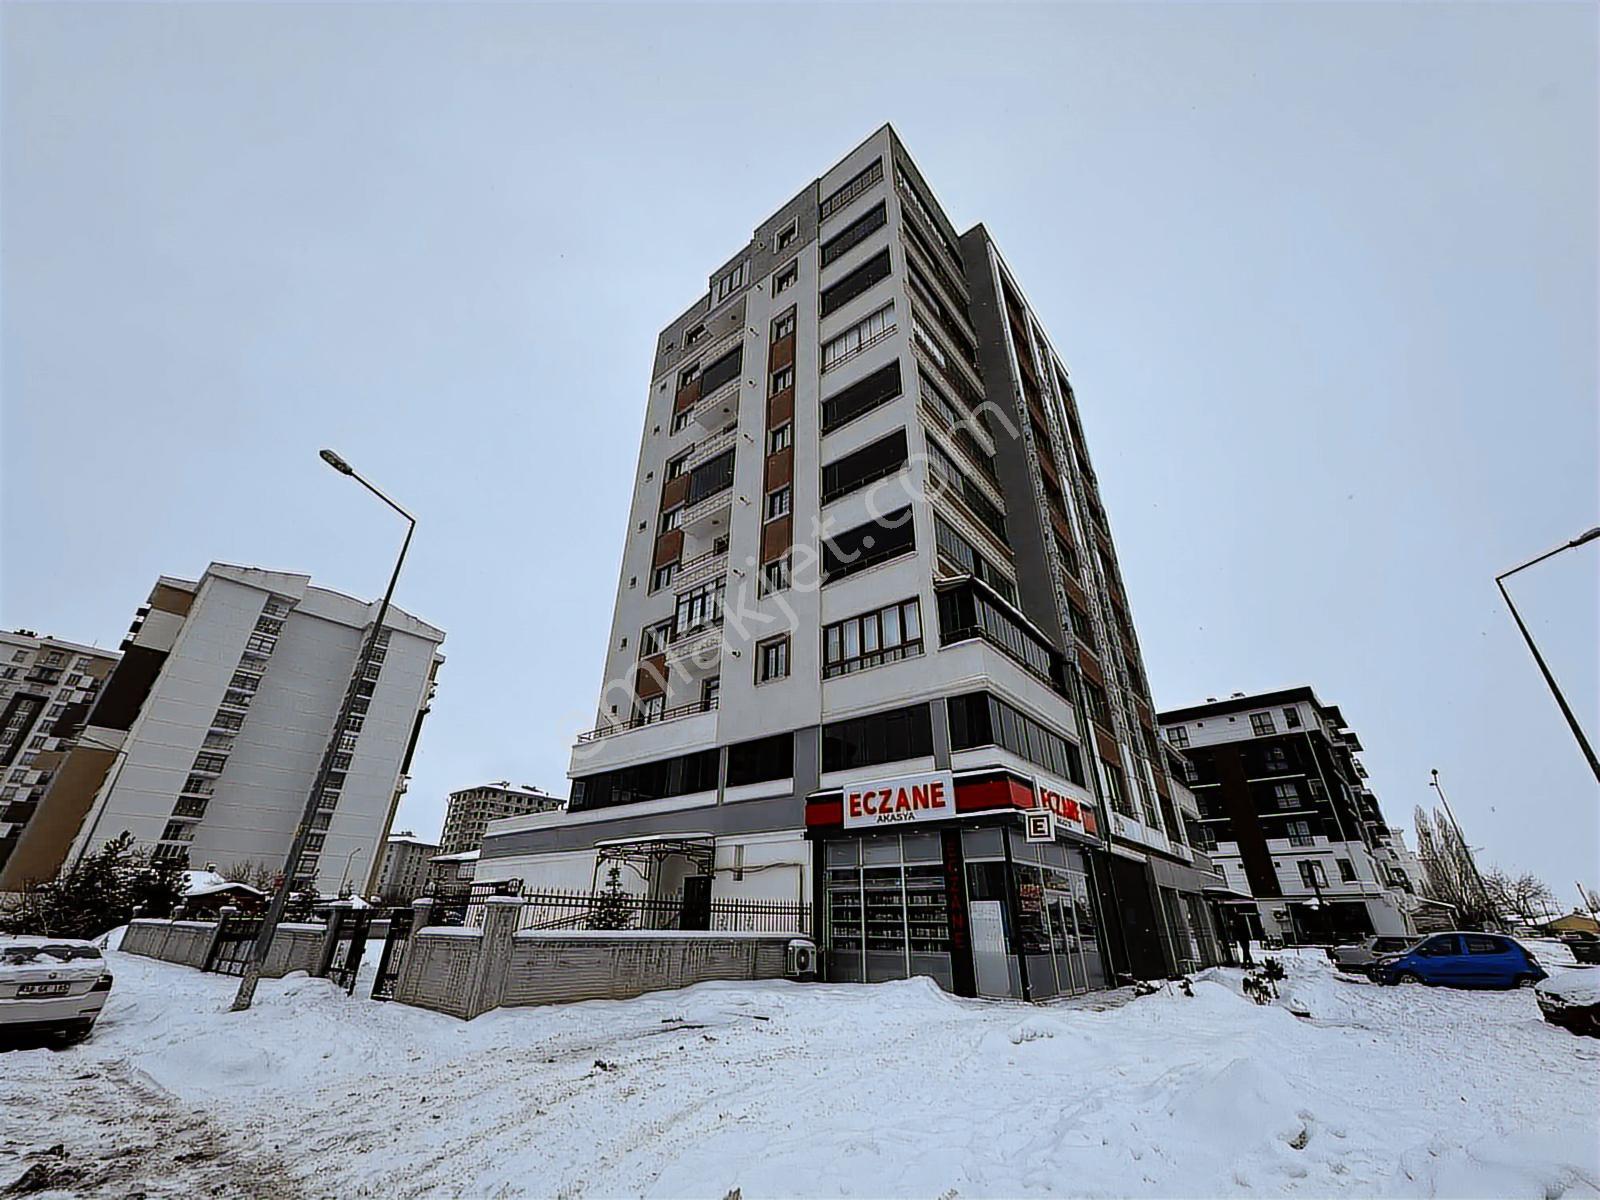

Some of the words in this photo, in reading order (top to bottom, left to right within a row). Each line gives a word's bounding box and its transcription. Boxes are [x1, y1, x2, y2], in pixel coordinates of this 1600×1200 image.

[849, 782, 946, 817] ECZANE
[876, 811, 916, 824] AKASYA
[1032, 819, 1045, 834] E
